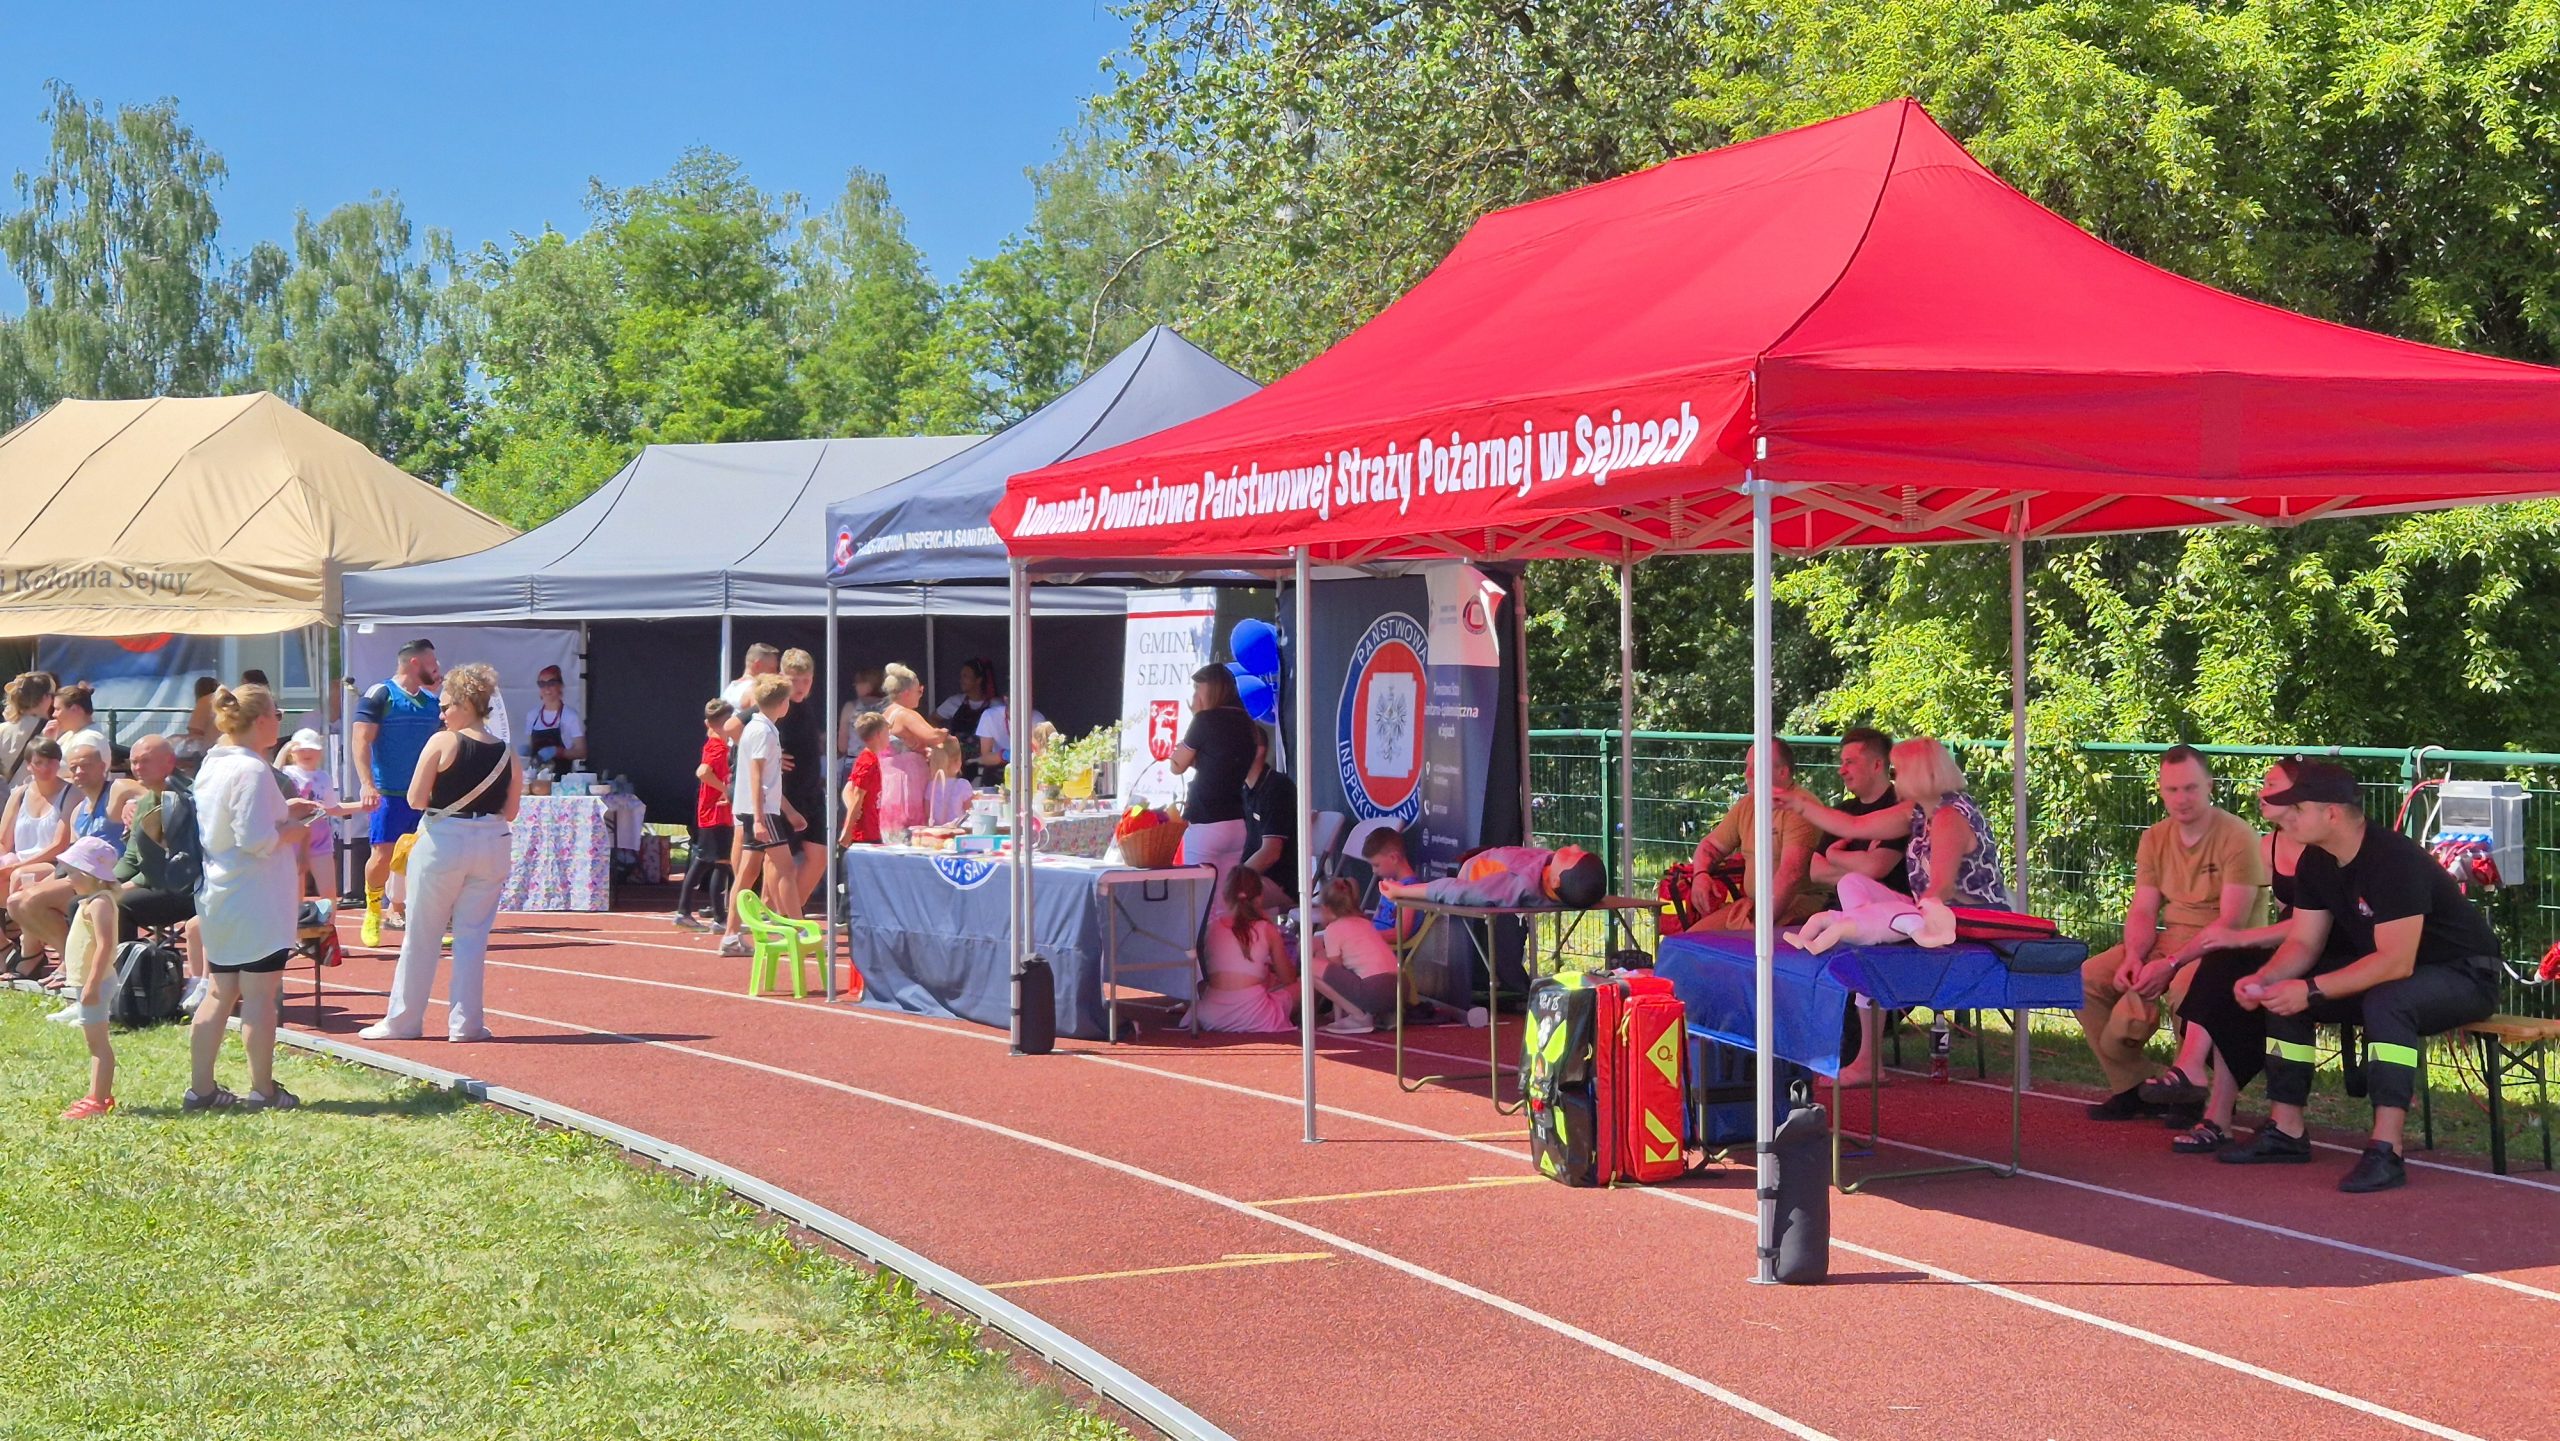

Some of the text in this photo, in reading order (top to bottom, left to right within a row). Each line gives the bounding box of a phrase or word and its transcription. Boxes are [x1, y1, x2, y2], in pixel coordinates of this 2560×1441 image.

[1013, 401, 1700, 537] Komenda Powiatowa Państwowej Straży Pożarnej w Sejnach
[905, 530, 953, 550] INSPEKCJA
[15, 564, 112, 592] Kolonia
[119, 565, 192, 596] Sejny
[1139, 630, 1198, 655] GMINA
[1137, 663, 1195, 686] SEJNY
